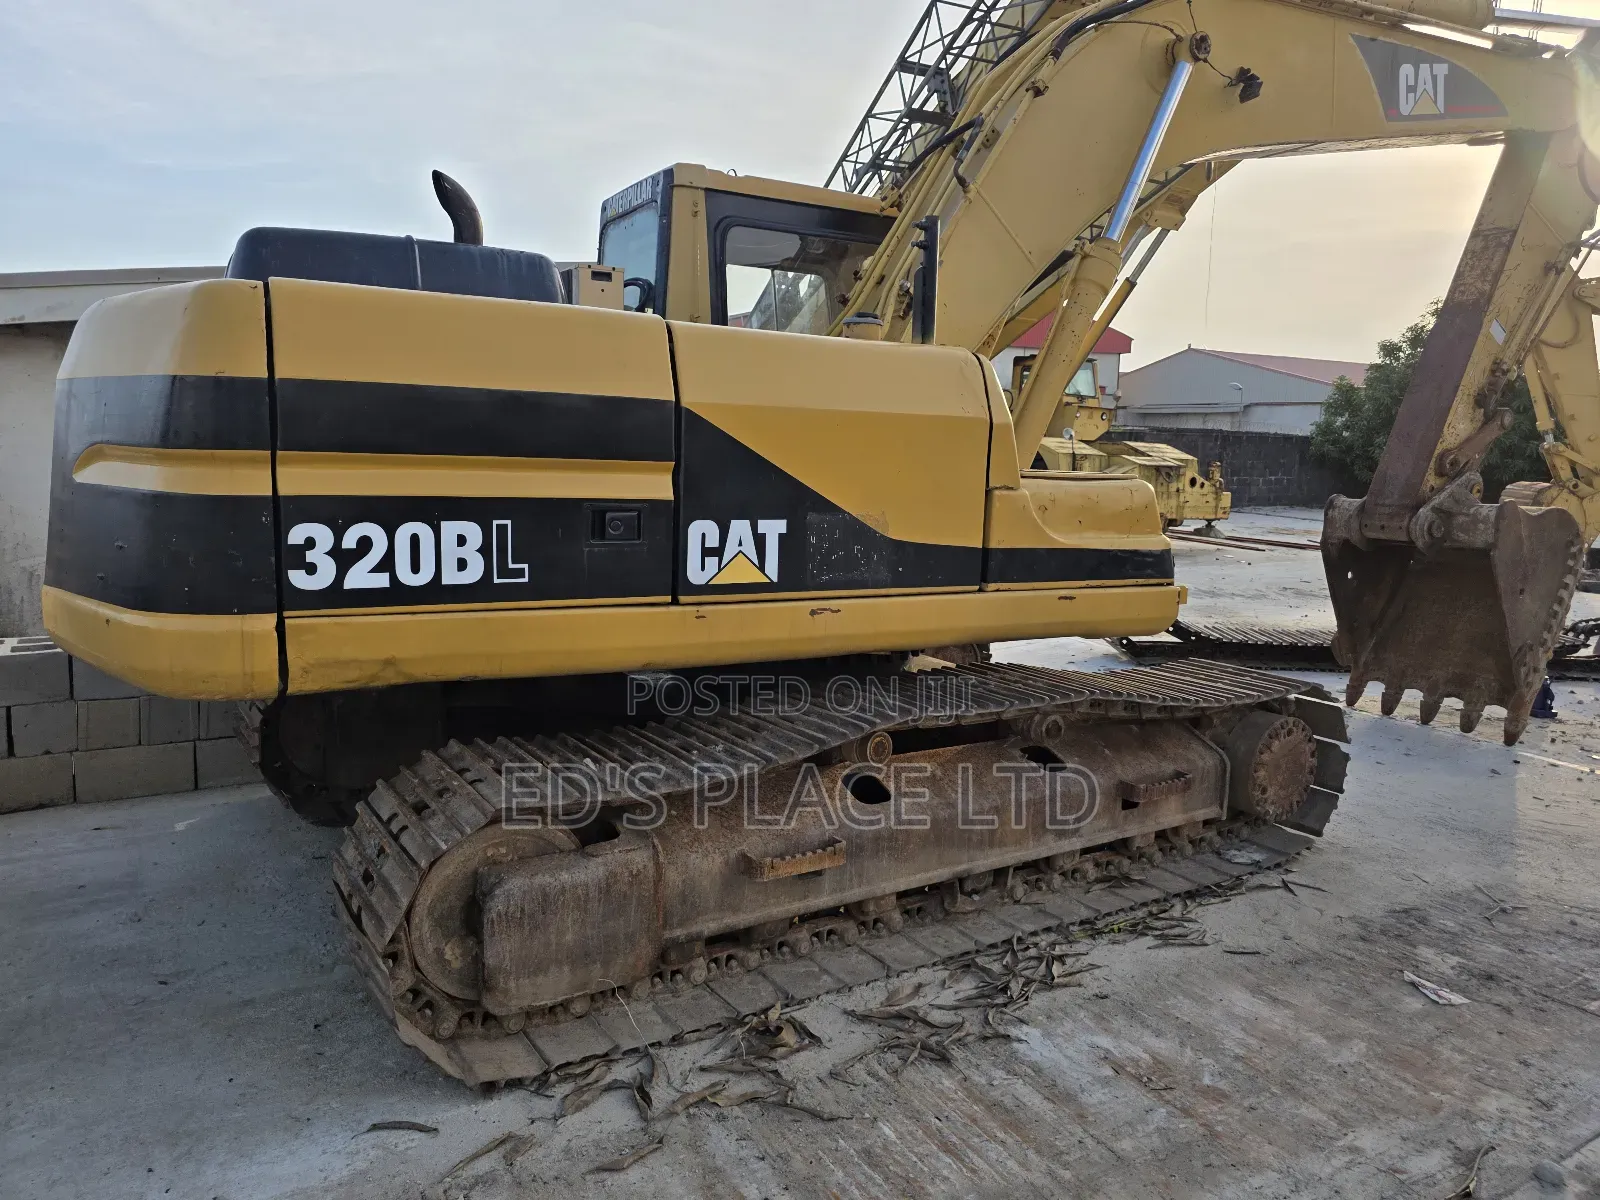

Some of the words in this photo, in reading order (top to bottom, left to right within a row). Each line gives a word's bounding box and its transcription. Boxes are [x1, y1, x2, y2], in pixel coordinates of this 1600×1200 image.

[1399, 63, 1449, 116] CAT
[607, 178, 652, 217] CATERPILLAR
[686, 518, 788, 585] CAT
